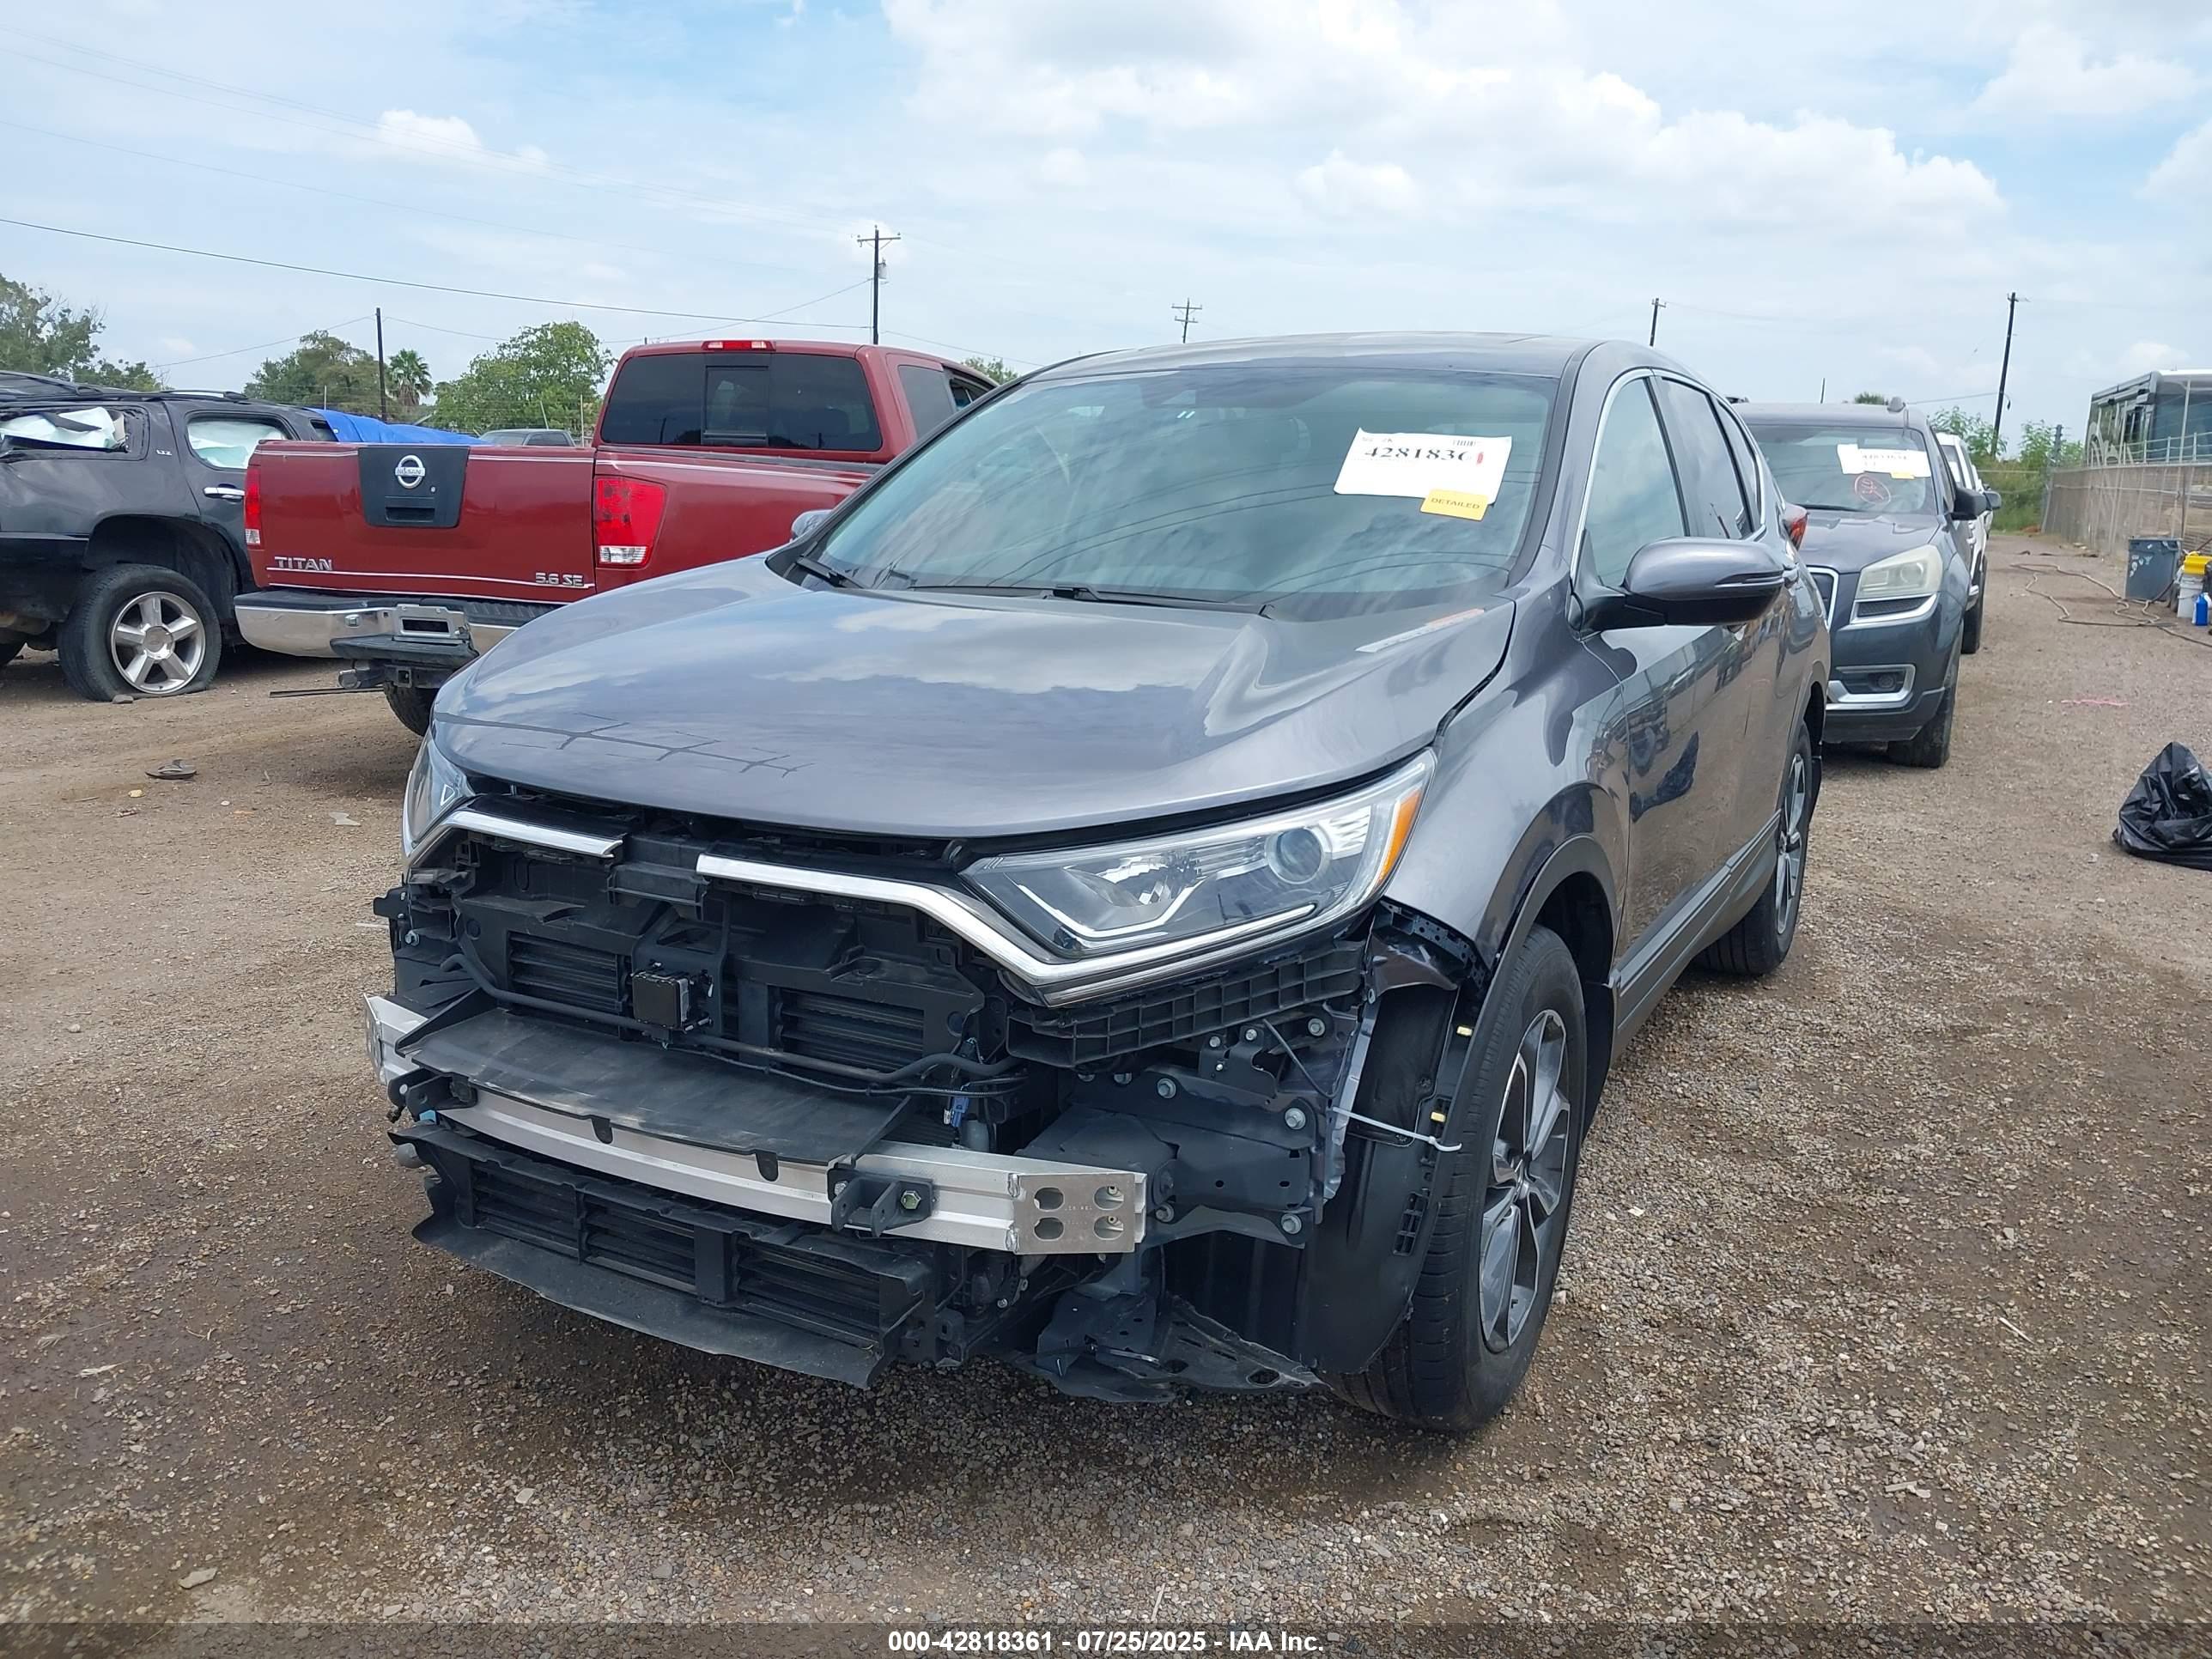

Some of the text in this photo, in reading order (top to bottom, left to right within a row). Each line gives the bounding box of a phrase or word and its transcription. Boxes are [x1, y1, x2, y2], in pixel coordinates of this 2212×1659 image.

[1431, 498, 1480, 509] DETAILED
[274, 556, 332, 571] TITAN
[535, 572, 584, 587] 5.6 SE
